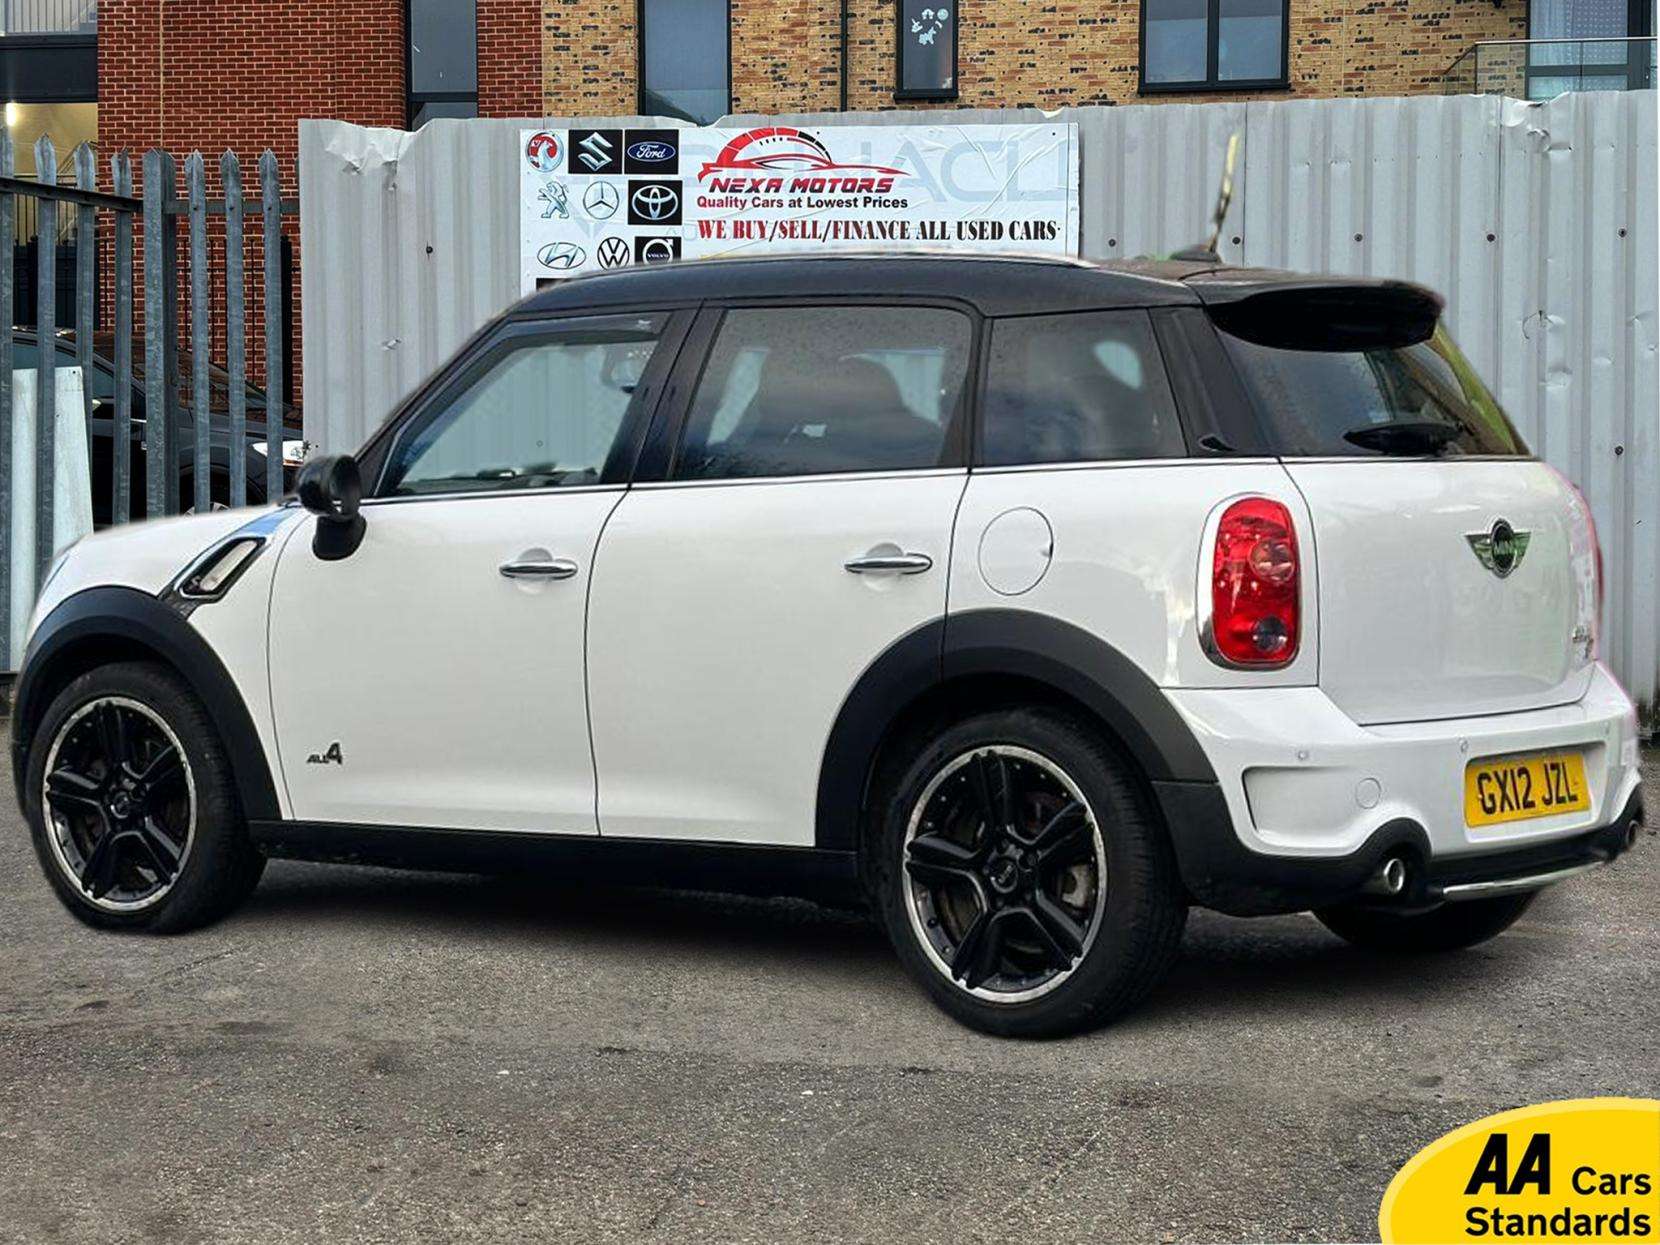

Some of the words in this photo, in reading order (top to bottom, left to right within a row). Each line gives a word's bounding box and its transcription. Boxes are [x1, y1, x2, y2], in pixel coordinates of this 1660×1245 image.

[636, 144, 666, 158] Ford
[709, 178, 784, 193] NEXA
[789, 178, 894, 193] MOTORS
[697, 196, 748, 209] Quality
[752, 196, 784, 208] Cars
[788, 197, 803, 208] at
[807, 196, 859, 208] Lowest
[863, 196, 908, 208] Prices
[698, 220, 727, 239] WE
[733, 219, 911, 242] BUY/SELL/FINANCE
[915, 220, 951, 240] ALL
[956, 220, 1003, 240] USED
[1008, 220, 1057, 240] CARS
[1476, 765, 1536, 815] GX12
[1541, 761, 1579, 806] JZL
